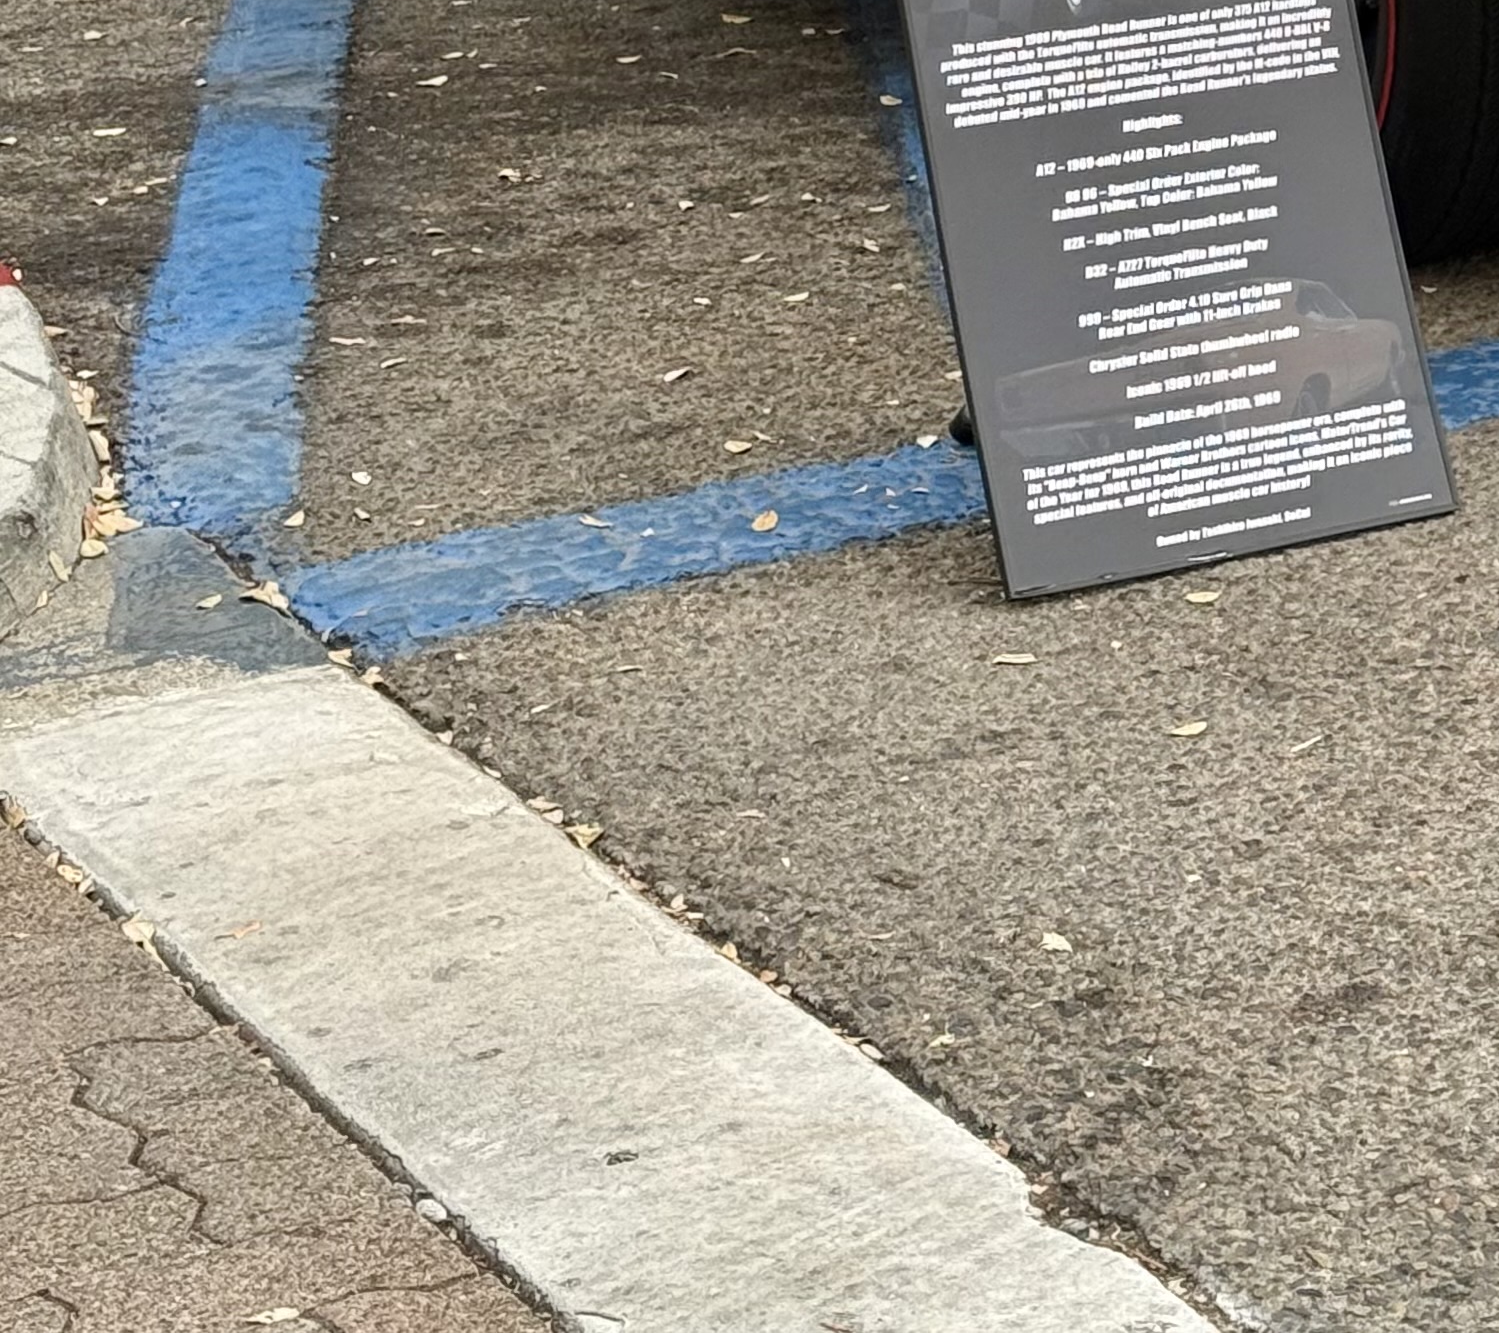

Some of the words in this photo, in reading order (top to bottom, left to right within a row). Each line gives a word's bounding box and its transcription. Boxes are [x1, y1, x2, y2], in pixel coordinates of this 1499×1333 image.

[1122, 113, 1184, 133] Highlights:
[1035, 162, 1056, 177] A12
[1122, 148, 1144, 163] 440
[1145, 147, 1163, 160] Six
[1163, 141, 1191, 158] Pack
[1192, 137, 1229, 153] Engine
[1230, 130, 1277, 147] Package
[1052, 204, 1099, 222] Bahama
[1099, 198, 1139, 214] Yellow,
[1140, 194, 1161, 207] Top
[1162, 188, 1195, 204] Color:
[1196, 181, 1241, 199] Bahama
[1242, 176, 1278, 191] Yellow
[1114, 269, 1172, 290] Automatic
[1172, 257, 1248, 280] Transmission
[1098, 325, 1126, 340] Rear
[1126, 319, 1148, 335] End
[1148, 316, 1176, 331] Gear
[1175, 311, 1202, 327] with
[1242, 298, 1281, 315] Brakes
[1089, 354, 1138, 374] Chrysler
[1139, 347, 1169, 365] Solid
[1169, 344, 1200, 359] State
[1200, 329, 1269, 354] thumbwheel
[1270, 325, 1300, 341] radio
[1163, 375, 1192, 392] 1969
[1193, 371, 1211, 387] 1/2
[1212, 365, 1247, 383] lift-off
[1248, 360, 1276, 377] hood
[1134, 411, 1165, 430] Build
[1166, 408, 1196, 423] Date:
[1195, 400, 1223, 418] April
[1253, 390, 1281, 407] 1969
